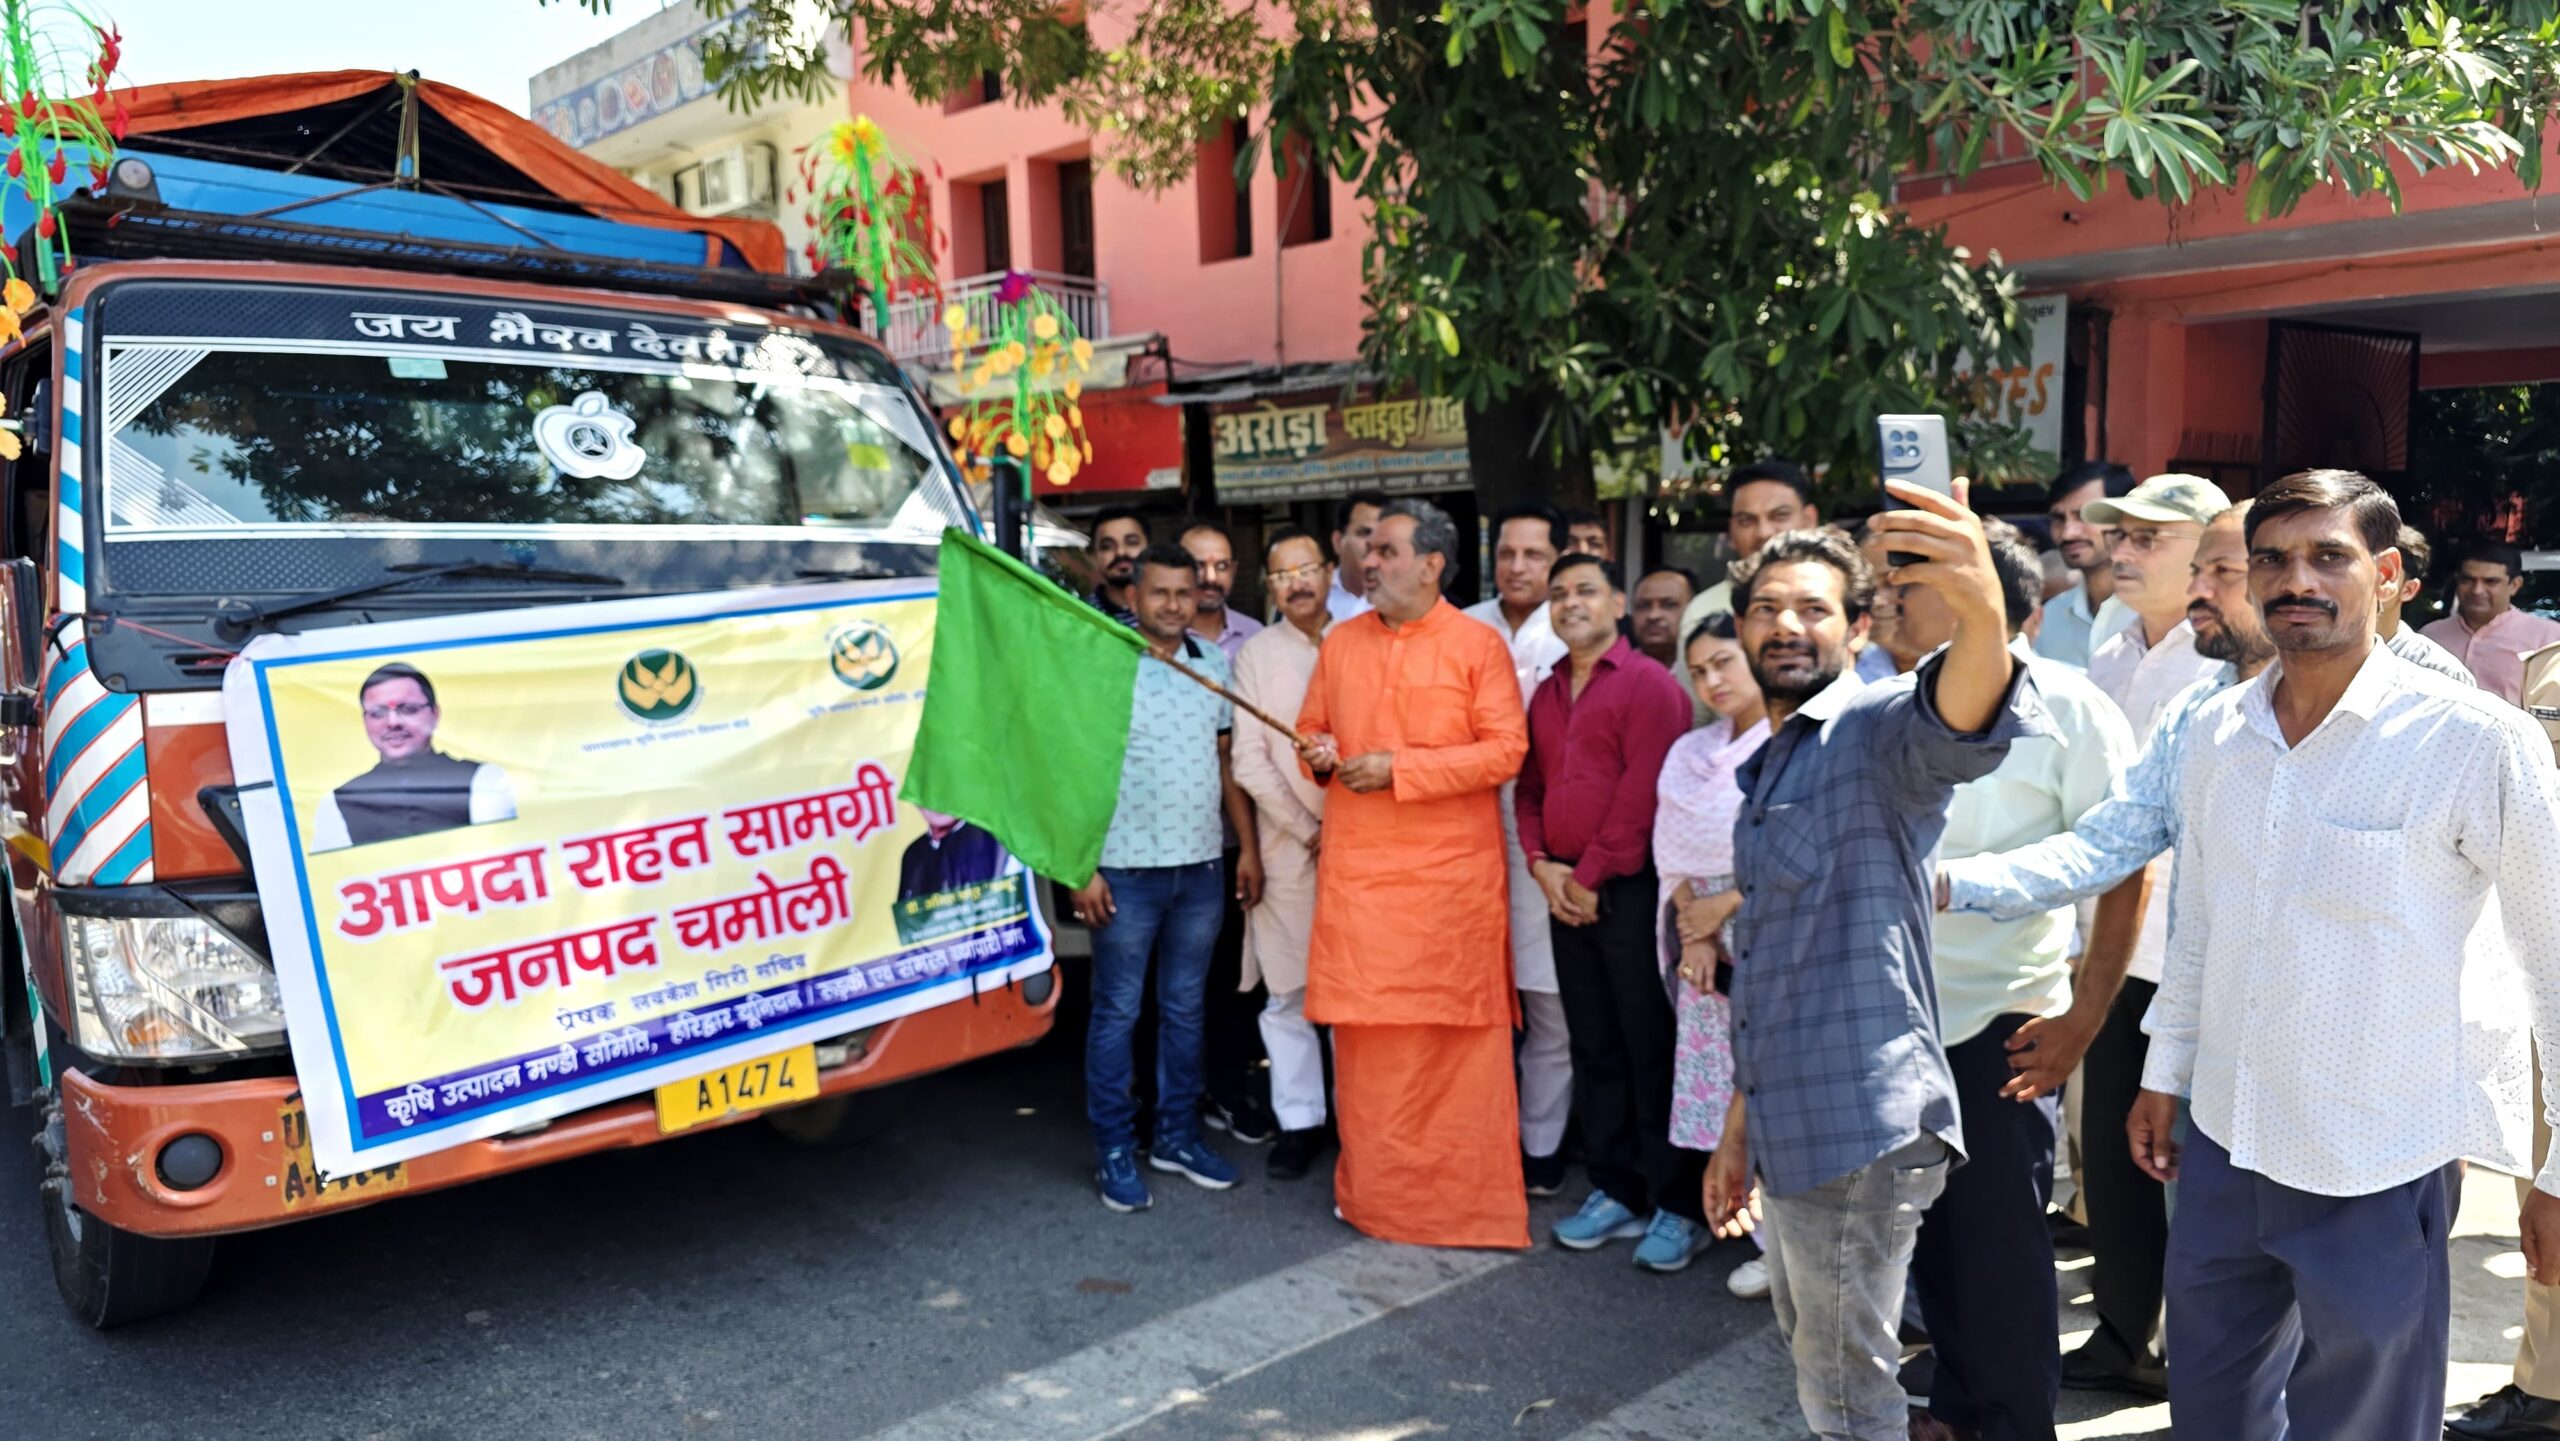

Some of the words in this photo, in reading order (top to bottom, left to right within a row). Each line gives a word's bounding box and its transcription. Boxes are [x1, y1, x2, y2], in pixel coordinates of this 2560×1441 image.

[351, 311, 462, 341] जय
[488, 311, 619, 352] भैरव
[1215, 400, 1330, 457] अरोड़ा
[338, 846, 549, 938] आपदा
[561, 814, 711, 889] राहत
[723, 763, 897, 857] सामग्री
[440, 915, 659, 1008] जनपद
[673, 855, 851, 951] चमोली
[556, 1001, 617, 1031] प्रेषक
[704, 964, 748, 992] गिरी
[755, 953, 806, 977] सचिव
[384, 1079, 436, 1127] कृषि
[440, 1063, 521, 1106] उत्पादन
[525, 1041, 579, 1082] मण्डी
[586, 1025, 659, 1068] समिति,
[666, 1010, 735, 1045] हरिद्वार
[733, 991, 803, 1030] यूनियन
[698, 1056, 794, 1112] A1474
